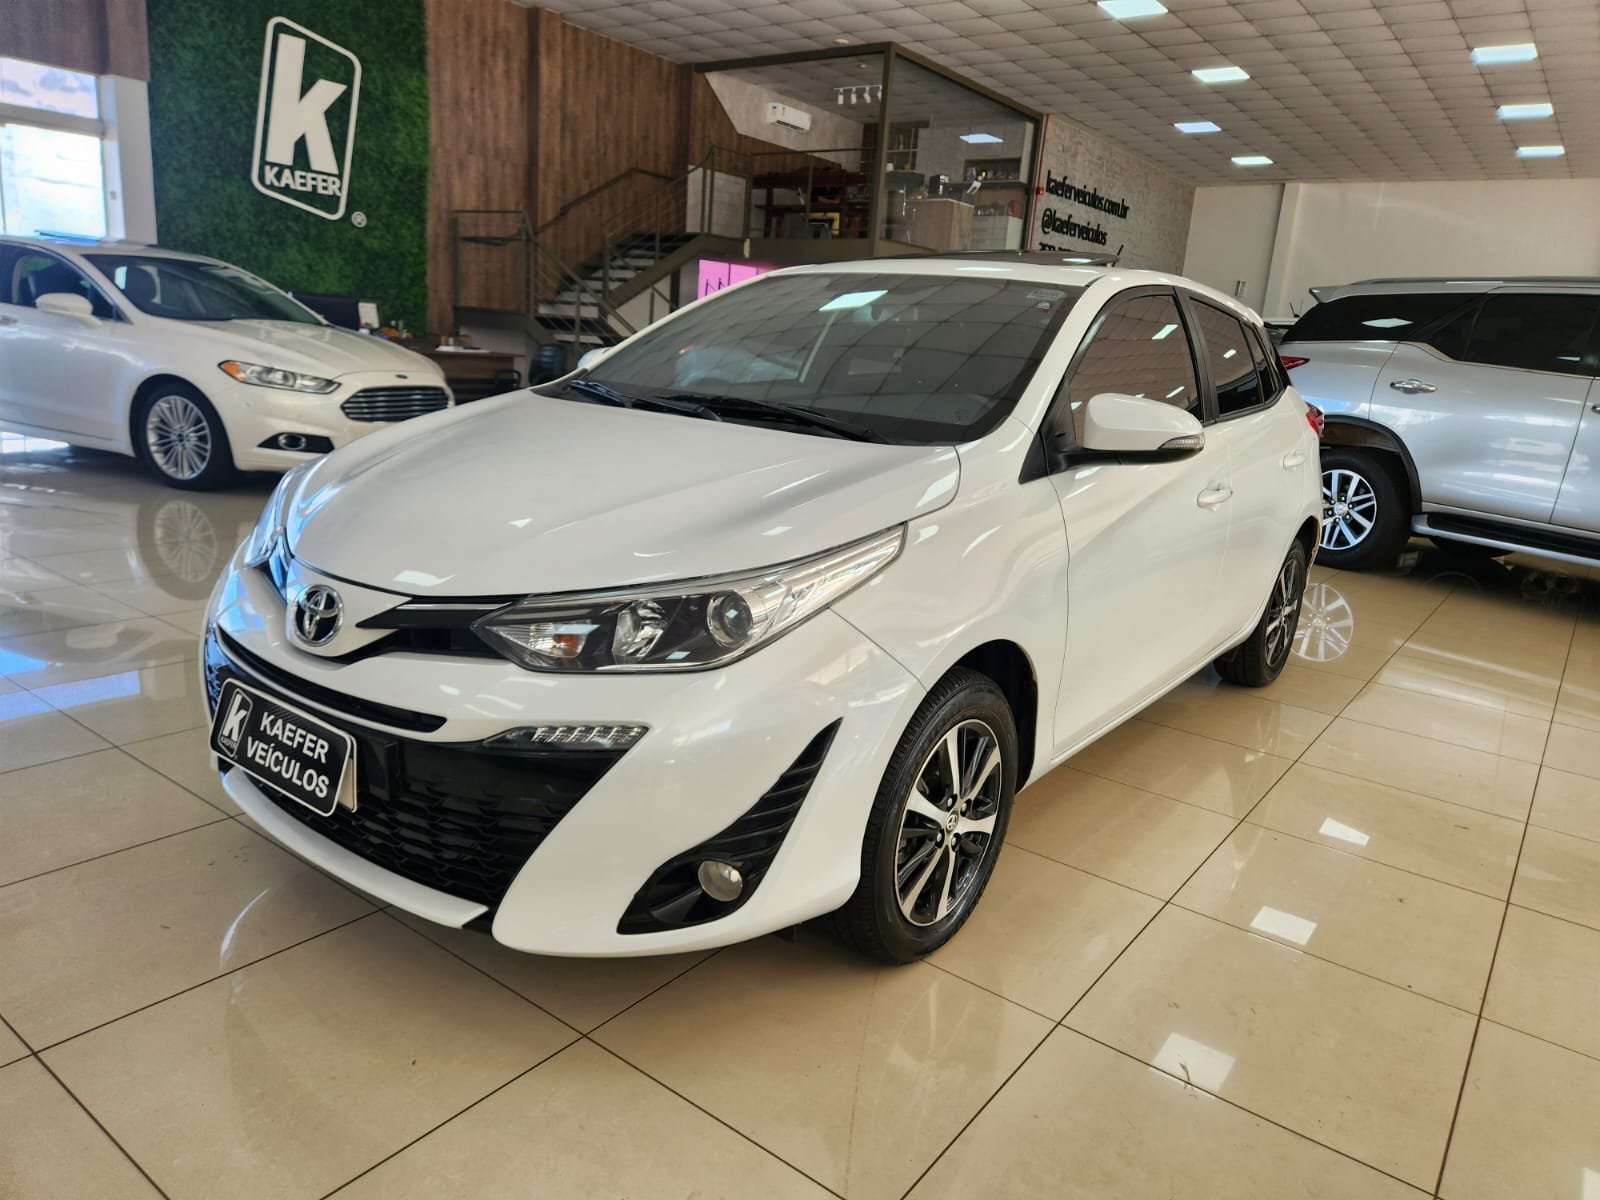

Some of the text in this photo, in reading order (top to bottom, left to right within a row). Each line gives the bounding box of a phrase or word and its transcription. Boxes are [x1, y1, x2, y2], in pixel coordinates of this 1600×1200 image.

[264, 165, 341, 196] KAEFER
[260, 712, 329, 764] KAEFER
[247, 736, 330, 798] VEÍCULOS
